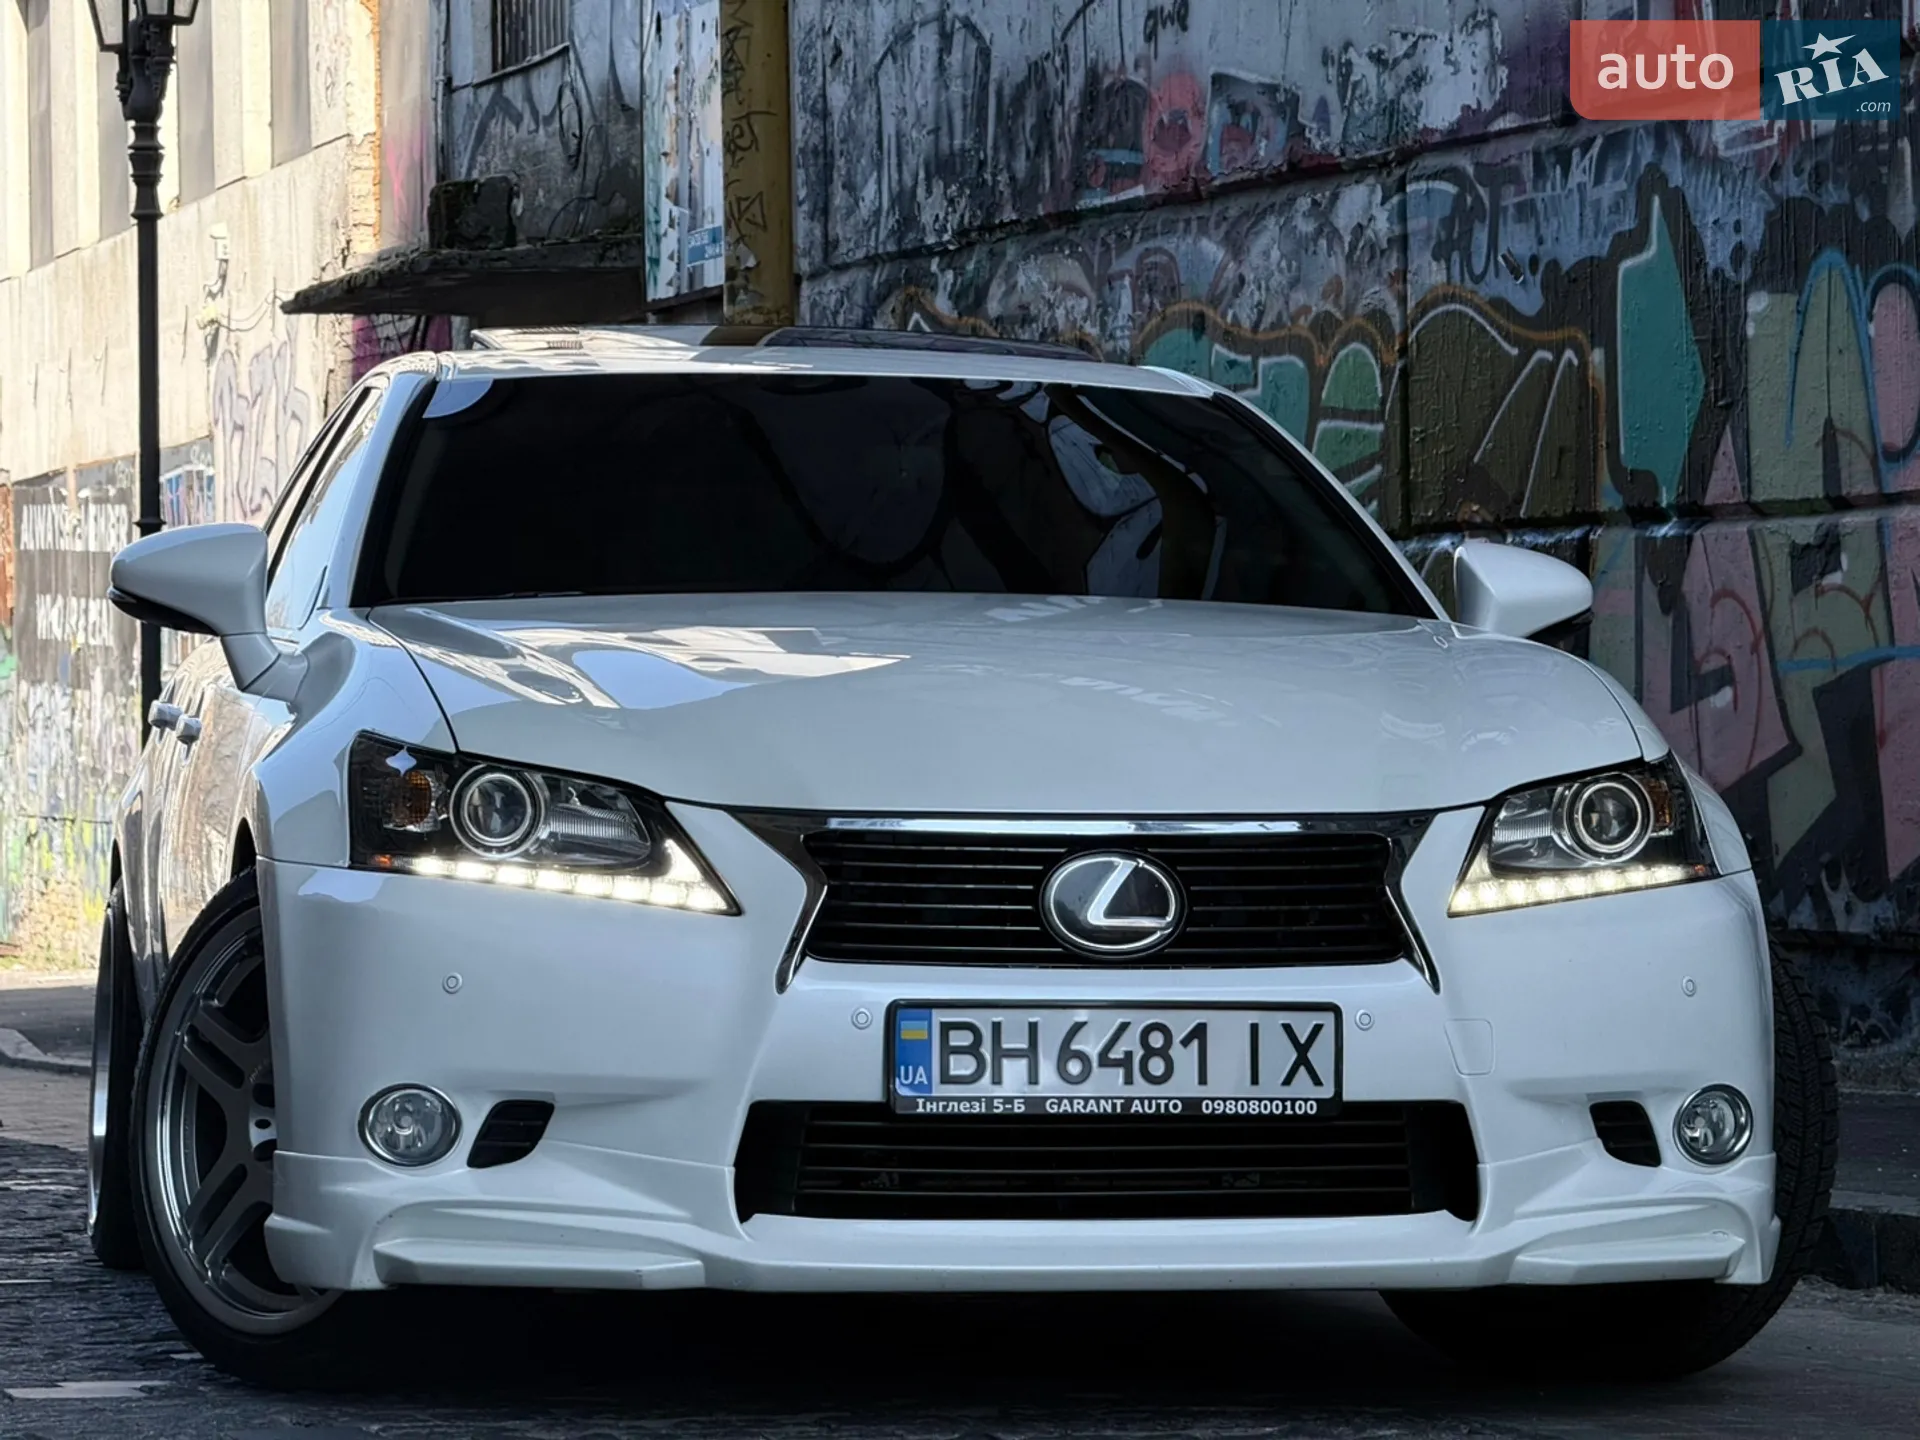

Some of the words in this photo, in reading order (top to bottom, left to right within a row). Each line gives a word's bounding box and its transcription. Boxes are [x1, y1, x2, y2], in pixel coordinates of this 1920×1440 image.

[939, 1020, 1040, 1086] BH
[1057, 1020, 1208, 1086] 6481
[1250, 1021, 1325, 1087] IX
[900, 1065, 928, 1085] UA
[916, 1098, 986, 1113] Інглезі
[993, 1099, 1026, 1113] 5-Б
[1045, 1099, 1125, 1114] GARANT
[1130, 1099, 1183, 1114] AUTO
[1201, 1099, 1318, 1115] 0980800100
